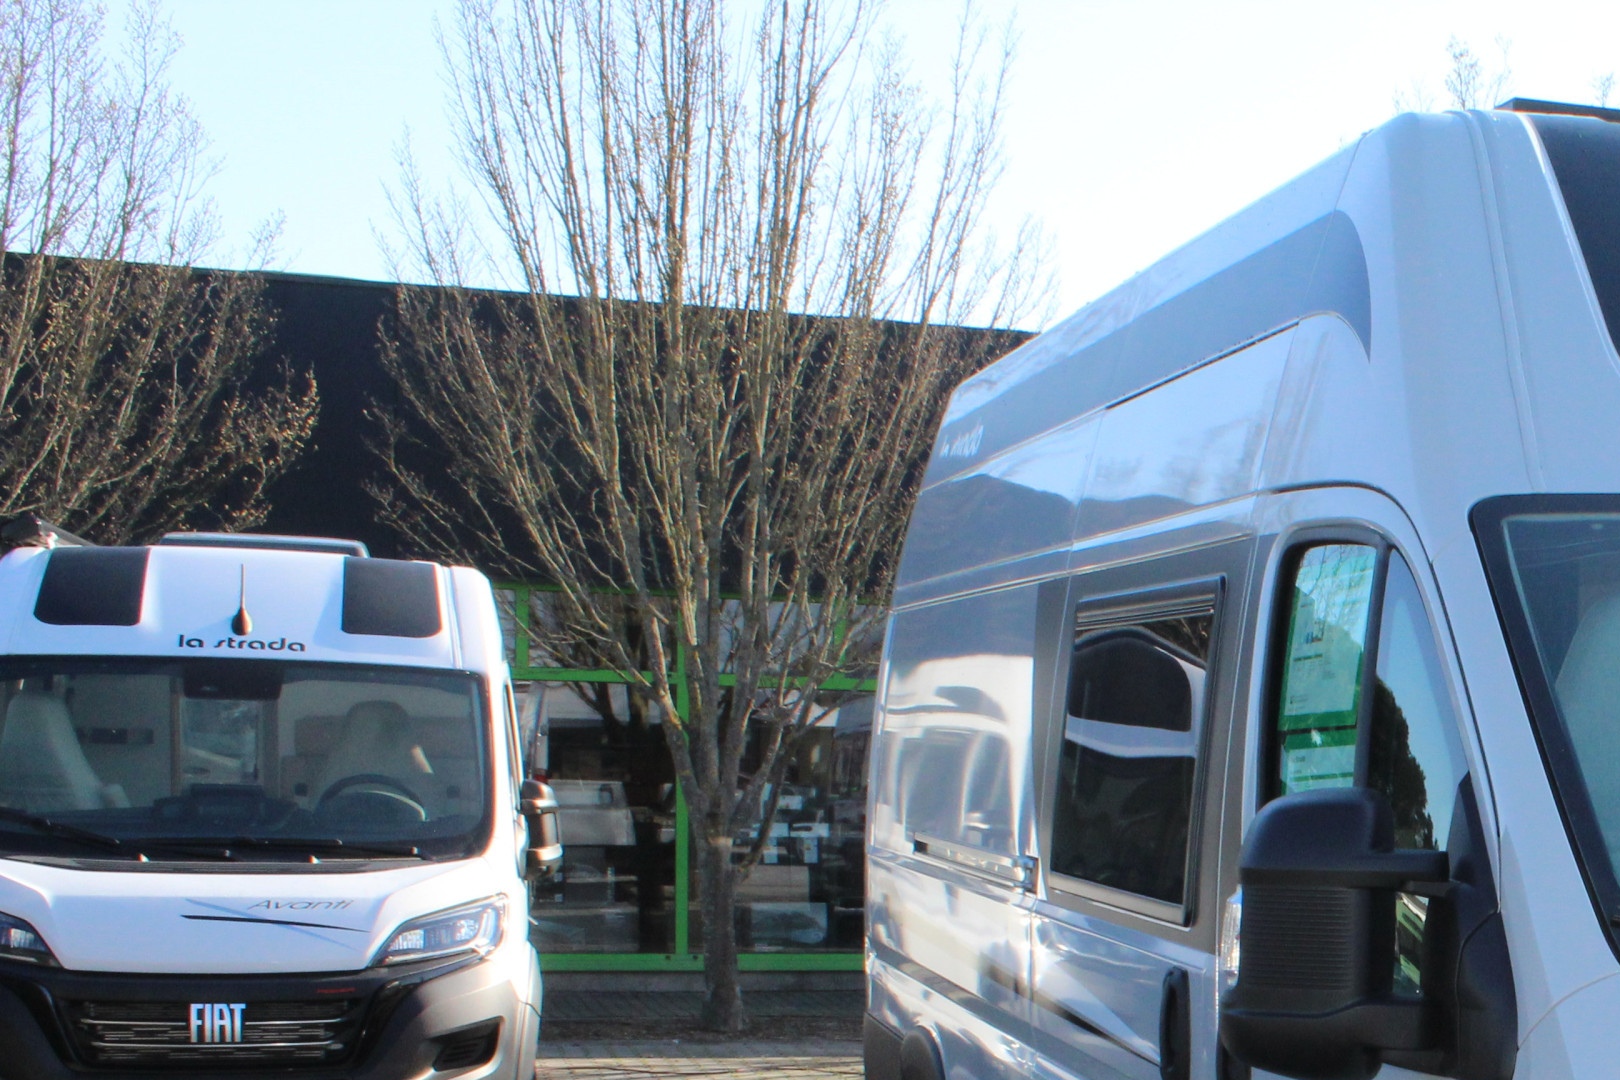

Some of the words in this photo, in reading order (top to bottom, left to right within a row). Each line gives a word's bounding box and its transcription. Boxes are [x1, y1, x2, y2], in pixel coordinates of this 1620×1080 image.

[178, 633, 205, 648] la
[213, 637, 306, 652] strada
[247, 899, 354, 911] Avanti
[189, 1002, 247, 1043] FIAT
